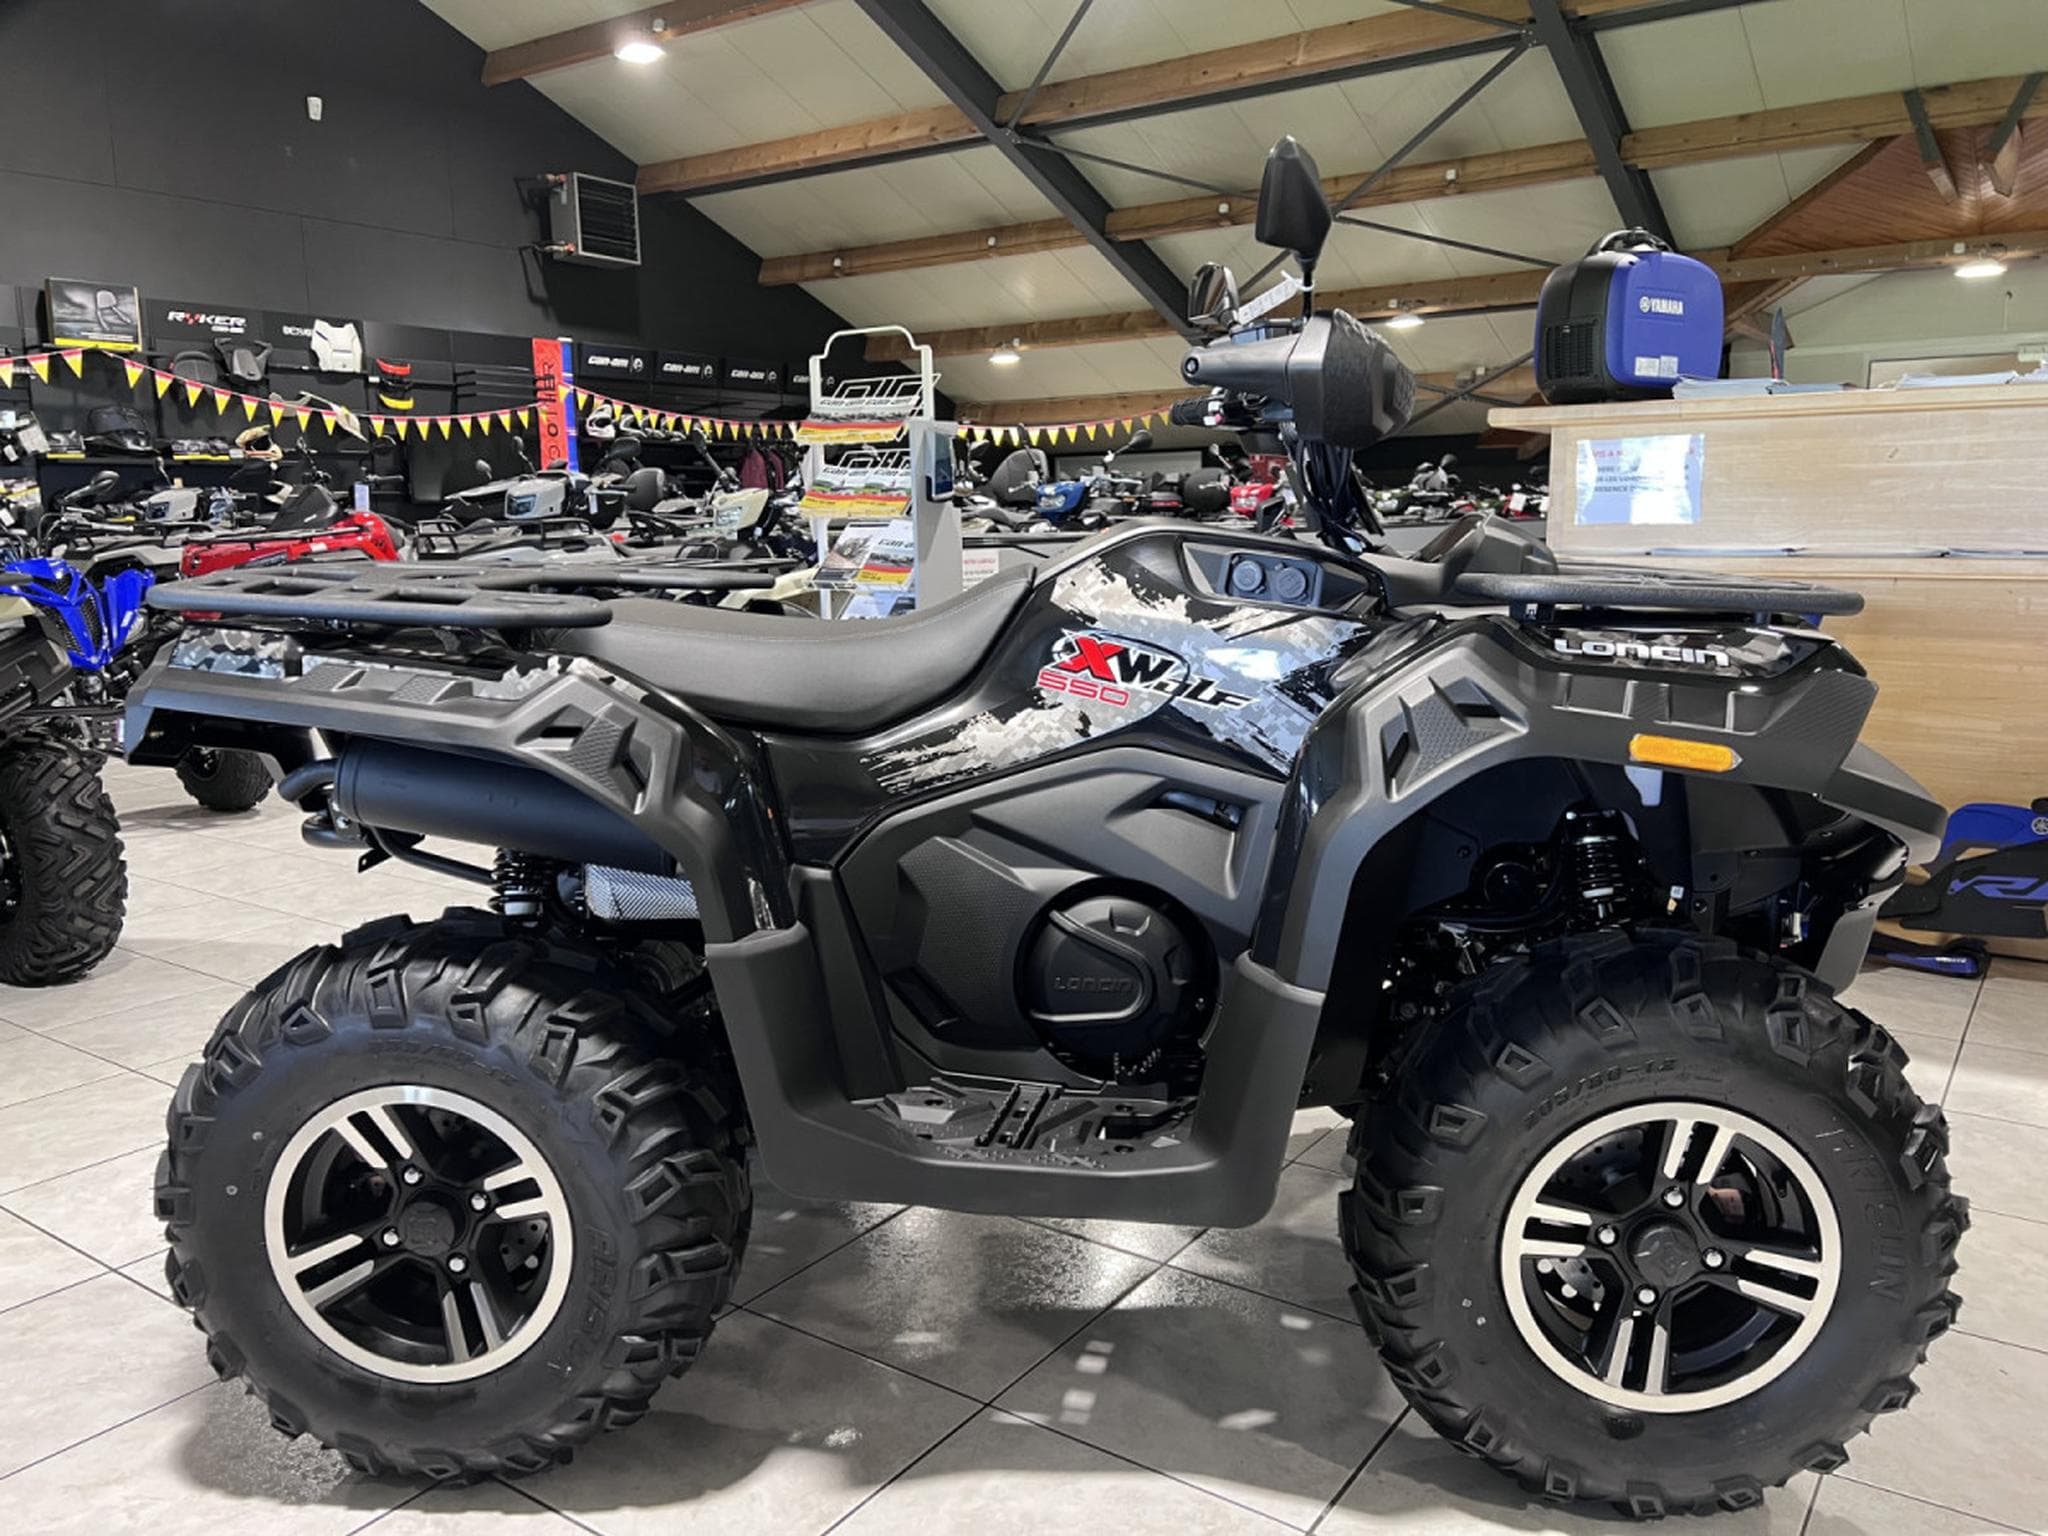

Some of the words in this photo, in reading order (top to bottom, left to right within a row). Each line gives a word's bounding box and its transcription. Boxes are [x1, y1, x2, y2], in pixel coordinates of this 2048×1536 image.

[1650, 297, 1684, 316] YAMAHA
[1553, 638, 1731, 668] LONCIN
[1037, 670, 1131, 708] 550
